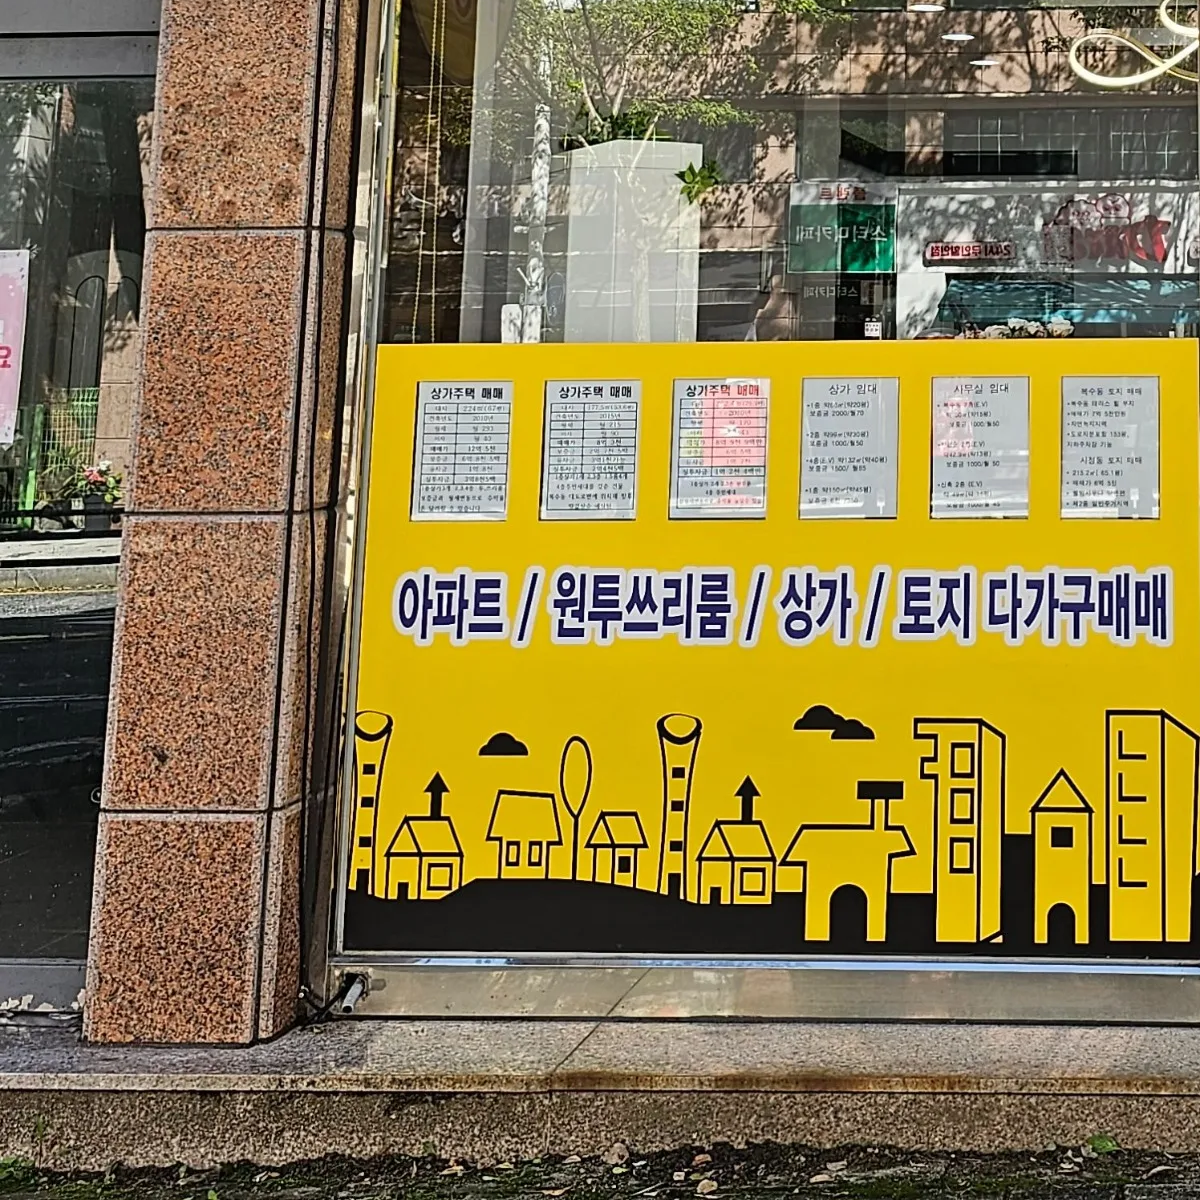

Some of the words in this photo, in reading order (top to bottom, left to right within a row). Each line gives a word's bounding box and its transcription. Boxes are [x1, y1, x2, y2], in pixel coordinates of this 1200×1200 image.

[431, 387, 476, 400] 상가주택
[481, 387, 503, 400] 매매
[559, 386, 604, 399] 상가주택
[610, 386, 632, 398] 매매
[686, 384, 731, 398] 상가주택
[737, 384, 759, 396] 매매
[828, 383, 851, 396] 상가
[856, 383, 878, 395] 임대
[954, 383, 984, 394] 사무실
[990, 383, 1009, 394] 임대
[1081, 388, 1103, 396] 복수동
[398, 572, 504, 641] 아파트
[552, 571, 732, 640] 원투쓰리룸
[779, 571, 853, 640] 상가
[898, 572, 971, 640] 토지
[987, 572, 1168, 641] 다가구매매
